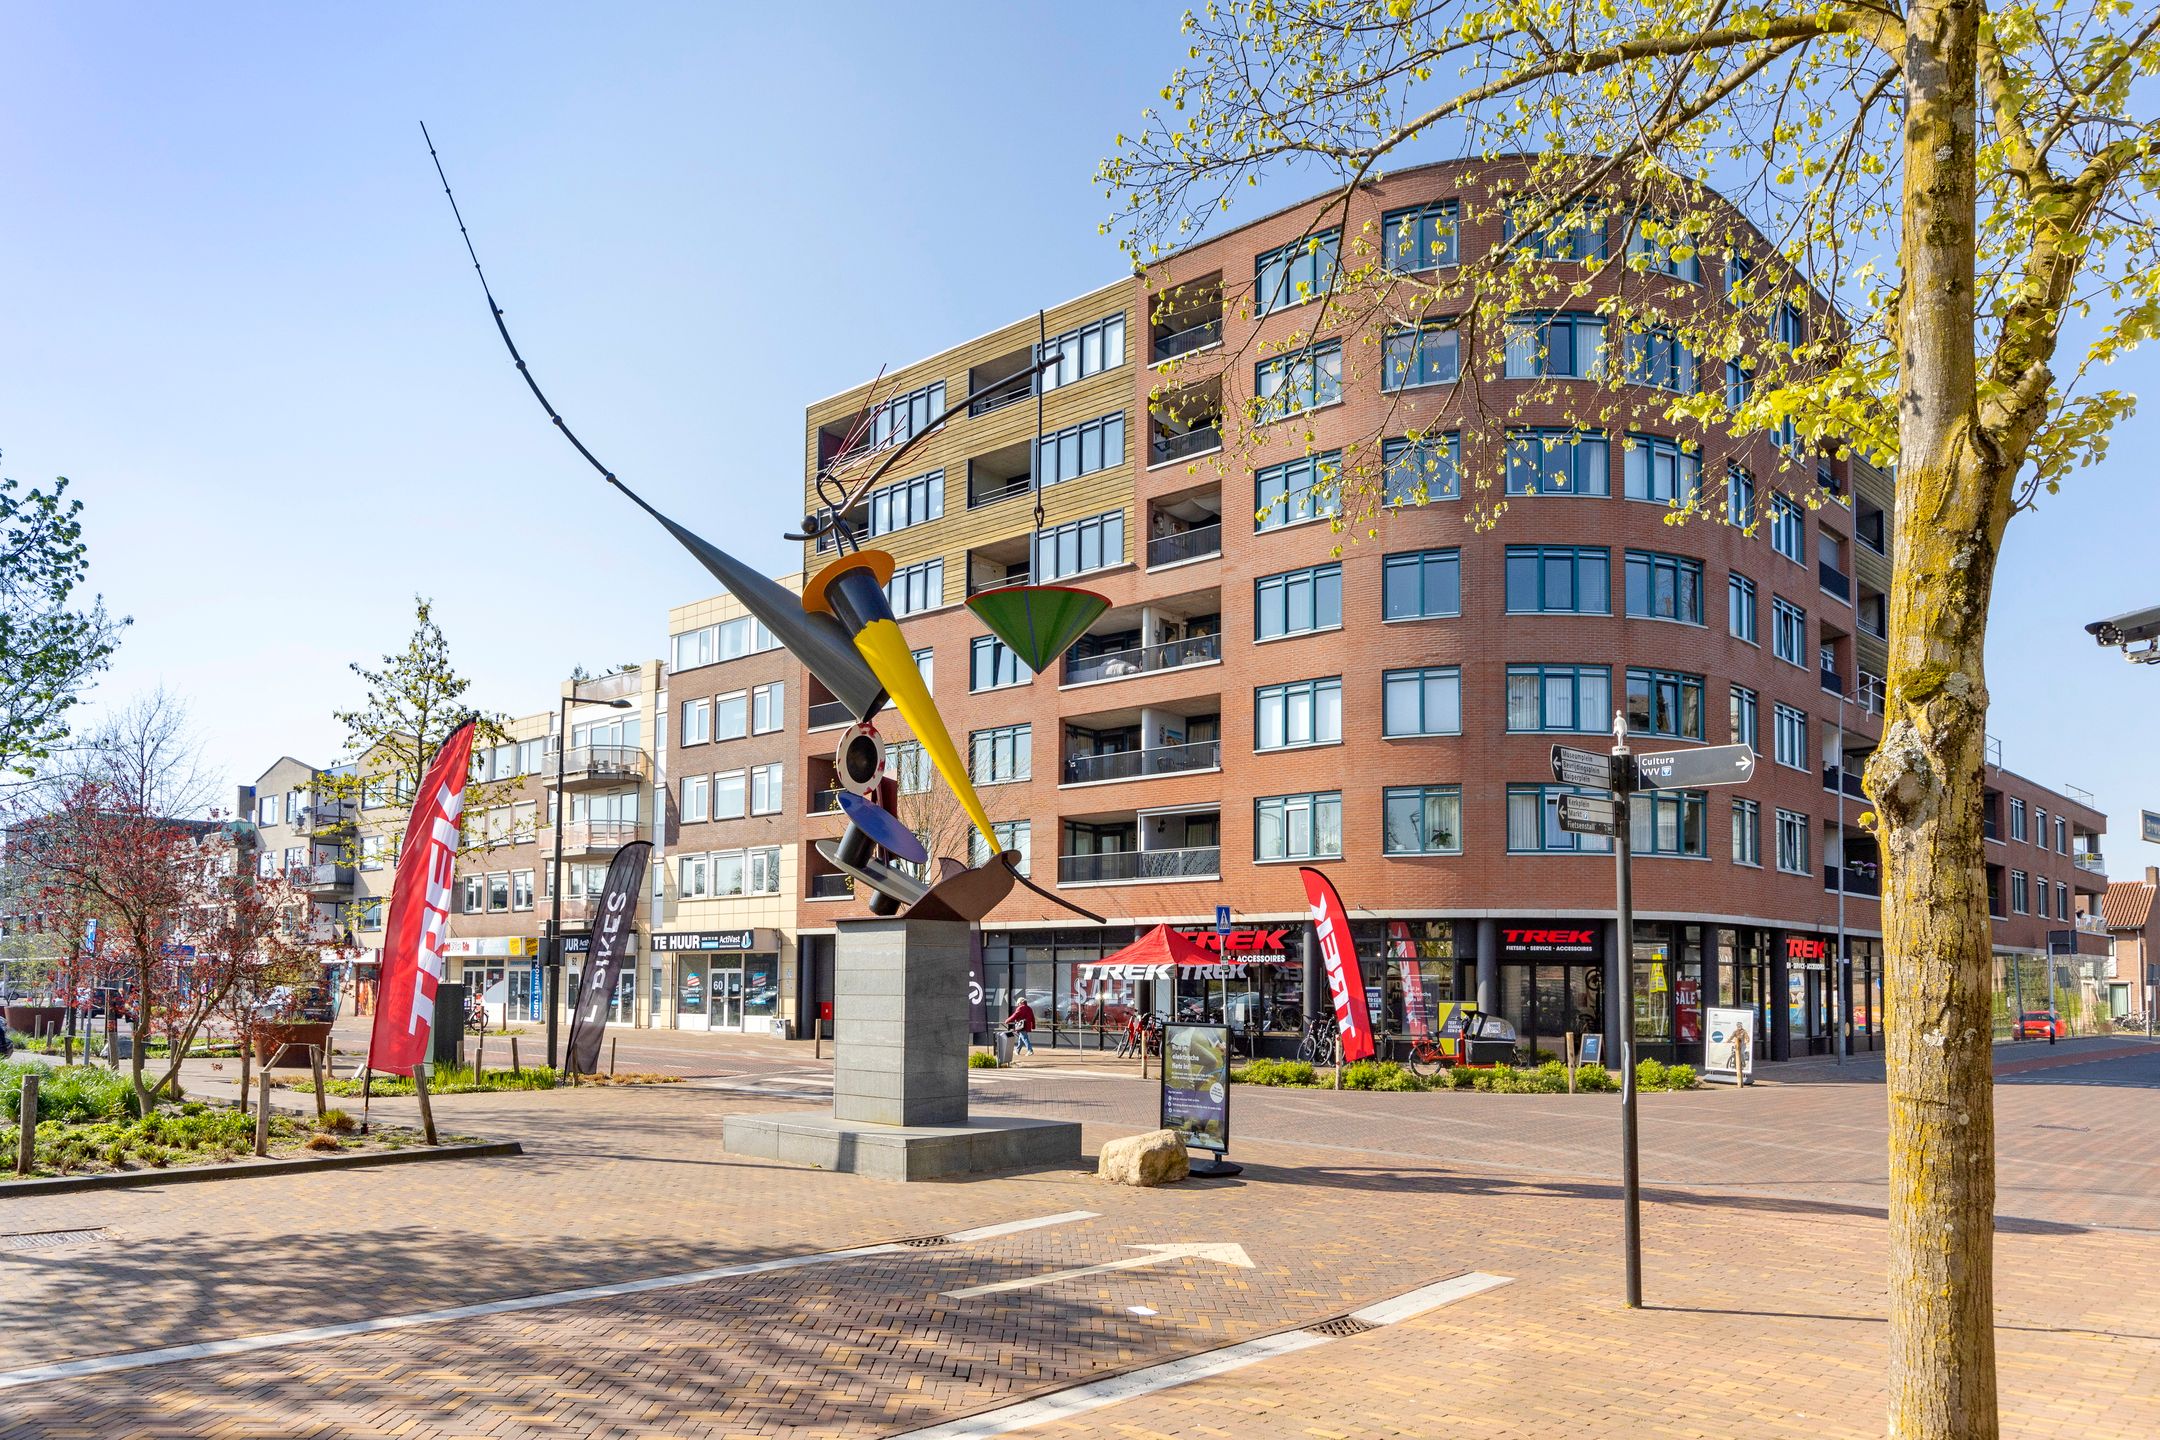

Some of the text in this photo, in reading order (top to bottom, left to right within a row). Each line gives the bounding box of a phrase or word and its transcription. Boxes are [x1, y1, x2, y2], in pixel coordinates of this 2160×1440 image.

[1562, 749, 1593, 763] Museumplein
[1641, 755, 1675, 767] Cultura
[1641, 767, 1660, 777] VVV
[1568, 809, 1582, 819] Markt
[1567, 820, 1596, 831] Fietsenstall
[408, 780, 465, 1036] TREK
[653, 936, 667, 950] TE
[669, 935, 700, 950] HUUR
[1503, 929, 1594, 943] TREK
[1786, 938, 1825, 959] REK
[1237, 955, 1286, 963] ACCESSOIRES
[1079, 964, 1176, 980] TREK
[1178, 964, 1249, 980] TREK
[713, 981, 724, 991] 60
[1074, 978, 1134, 1005] SALE
[1676, 991, 1696, 1005] SALE
[1172, 1053, 1199, 1062] elektrische
